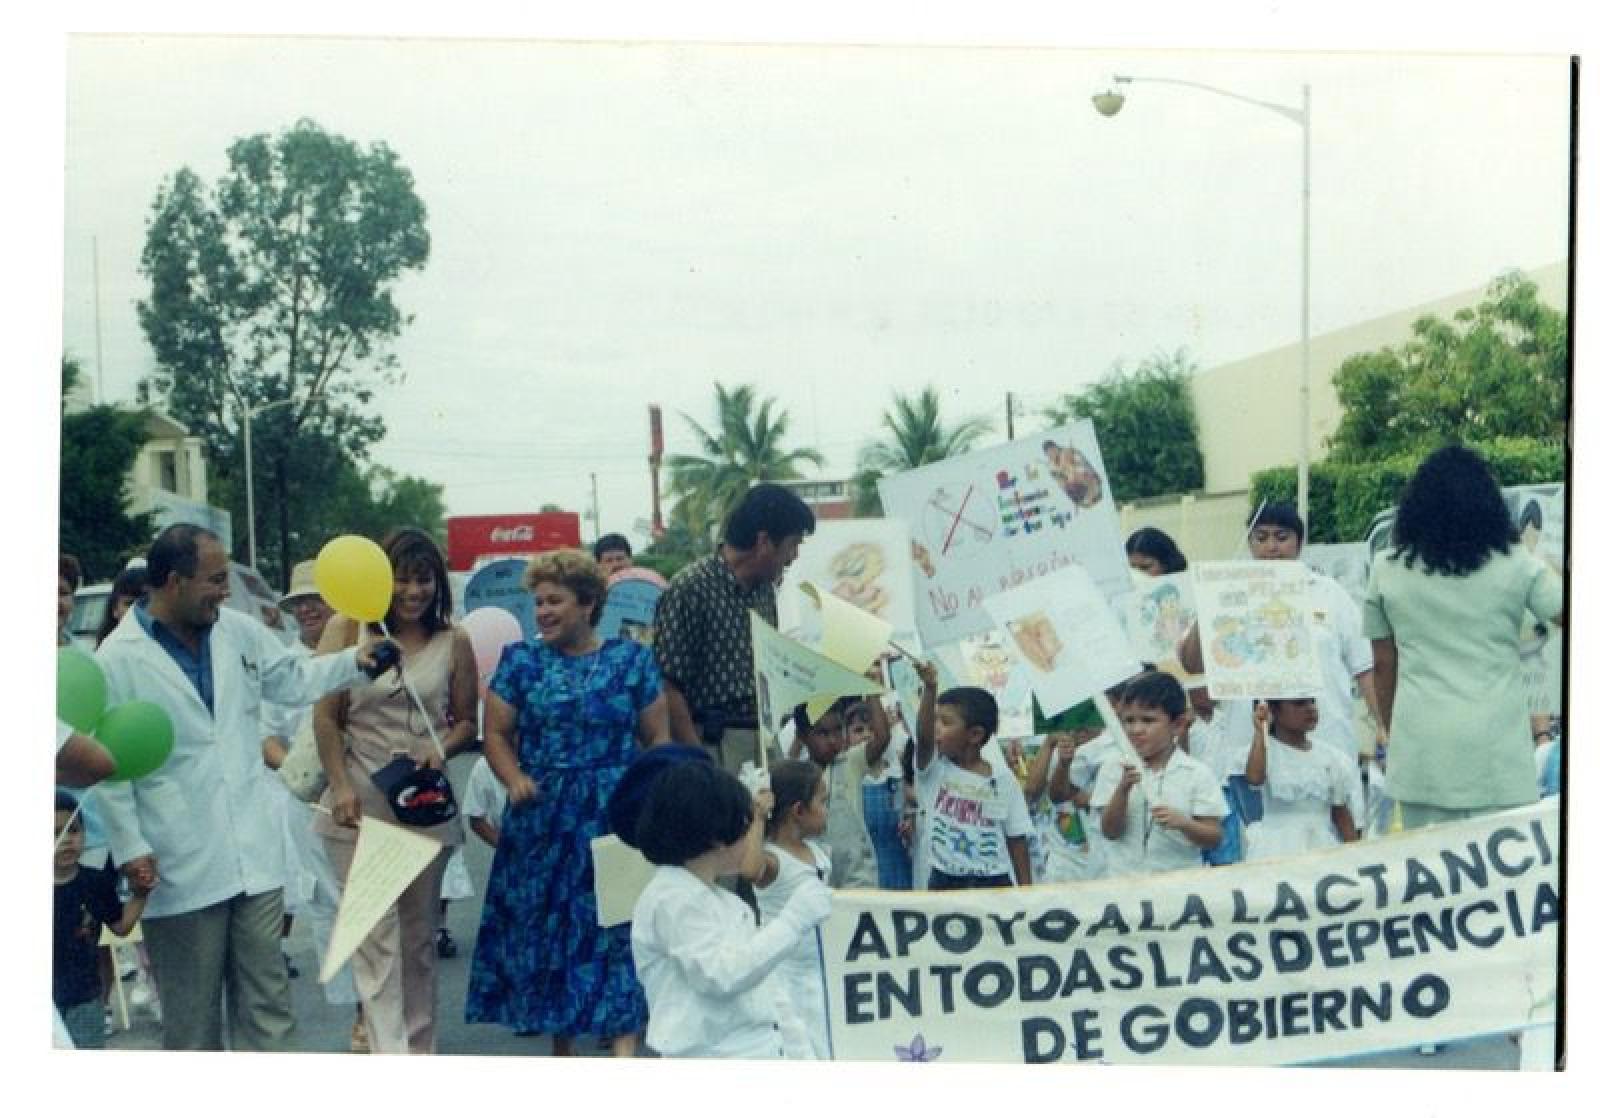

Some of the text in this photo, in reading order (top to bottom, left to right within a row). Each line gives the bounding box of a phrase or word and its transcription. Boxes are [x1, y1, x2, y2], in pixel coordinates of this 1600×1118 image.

[843, 881, 1561, 1025] EN TODAS LAS DEPENCIA
[845, 908, 1081, 962] APOYO
[1231, 820, 1553, 923] LACTANCI
[1021, 973, 1451, 1065] DE GOBIERNO
